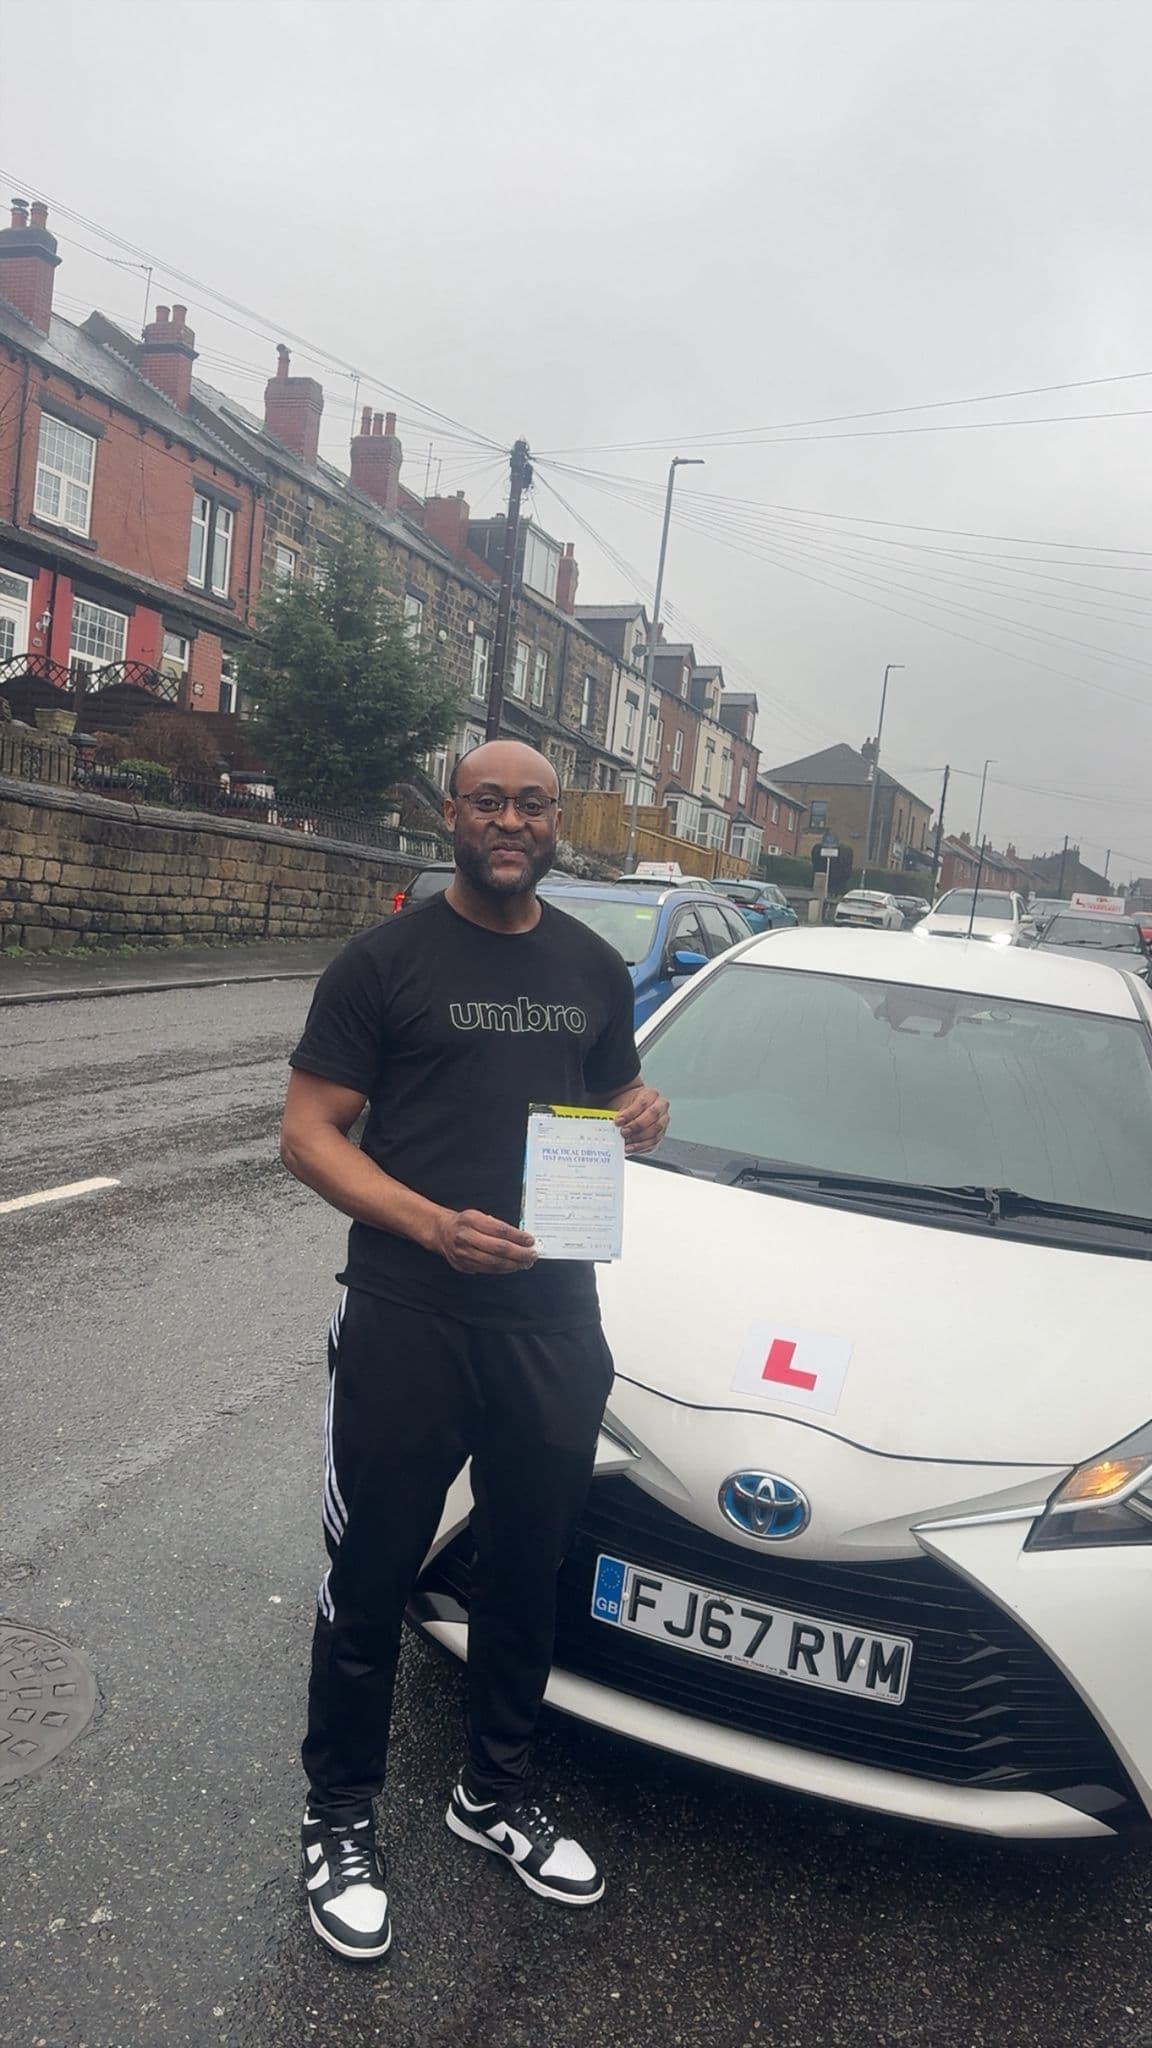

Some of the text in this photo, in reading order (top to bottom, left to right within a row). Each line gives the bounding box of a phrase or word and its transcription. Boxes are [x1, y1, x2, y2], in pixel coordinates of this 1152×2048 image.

[449, 996, 587, 1034] umbro
[761, 1338, 818, 1392] L
[596, 1597, 618, 1615] GB
[627, 1574, 906, 1695] FJ67 RVM
